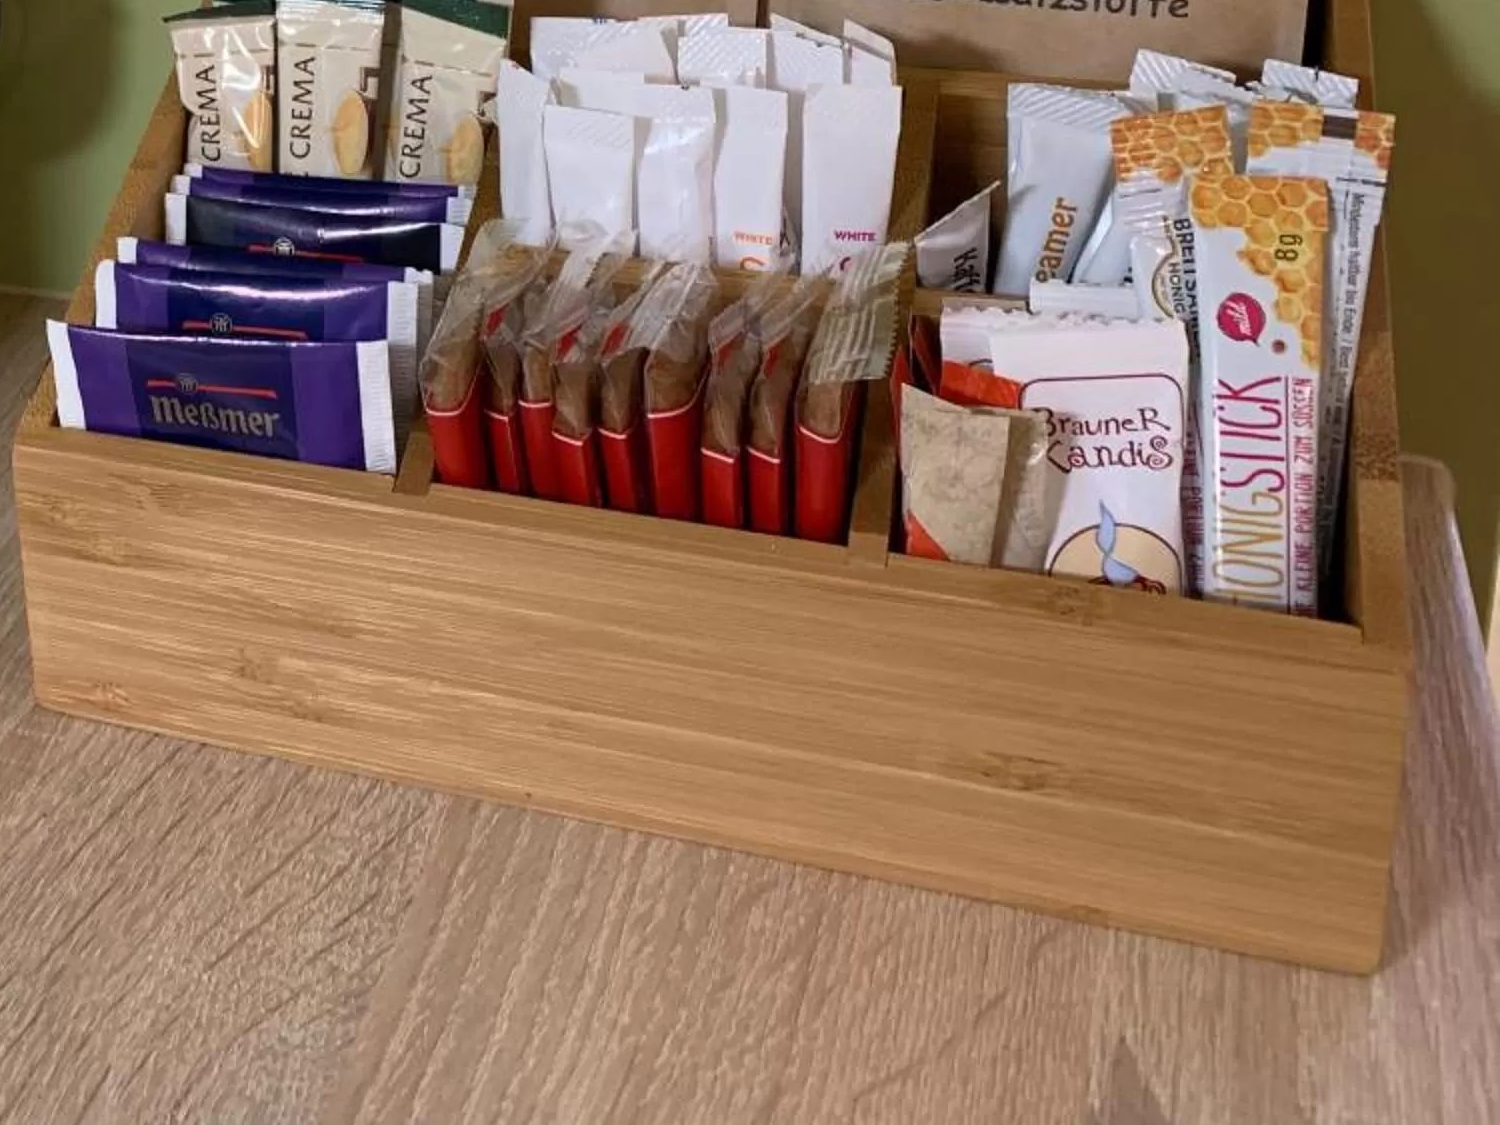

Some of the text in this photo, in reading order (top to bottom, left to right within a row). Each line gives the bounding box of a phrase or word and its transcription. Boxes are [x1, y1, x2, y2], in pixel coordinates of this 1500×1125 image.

[195, 63, 222, 163] CREMA
[289, 56, 316, 160] CREMA
[399, 74, 434, 179] CREMA
[833, 230, 877, 243] WHITE
[1274, 234, 1303, 262] 8g
[1167, 262, 1186, 314] HONIG
[149, 394, 281, 438] Meßmer
[1292, 474, 1315, 534] PORTION
